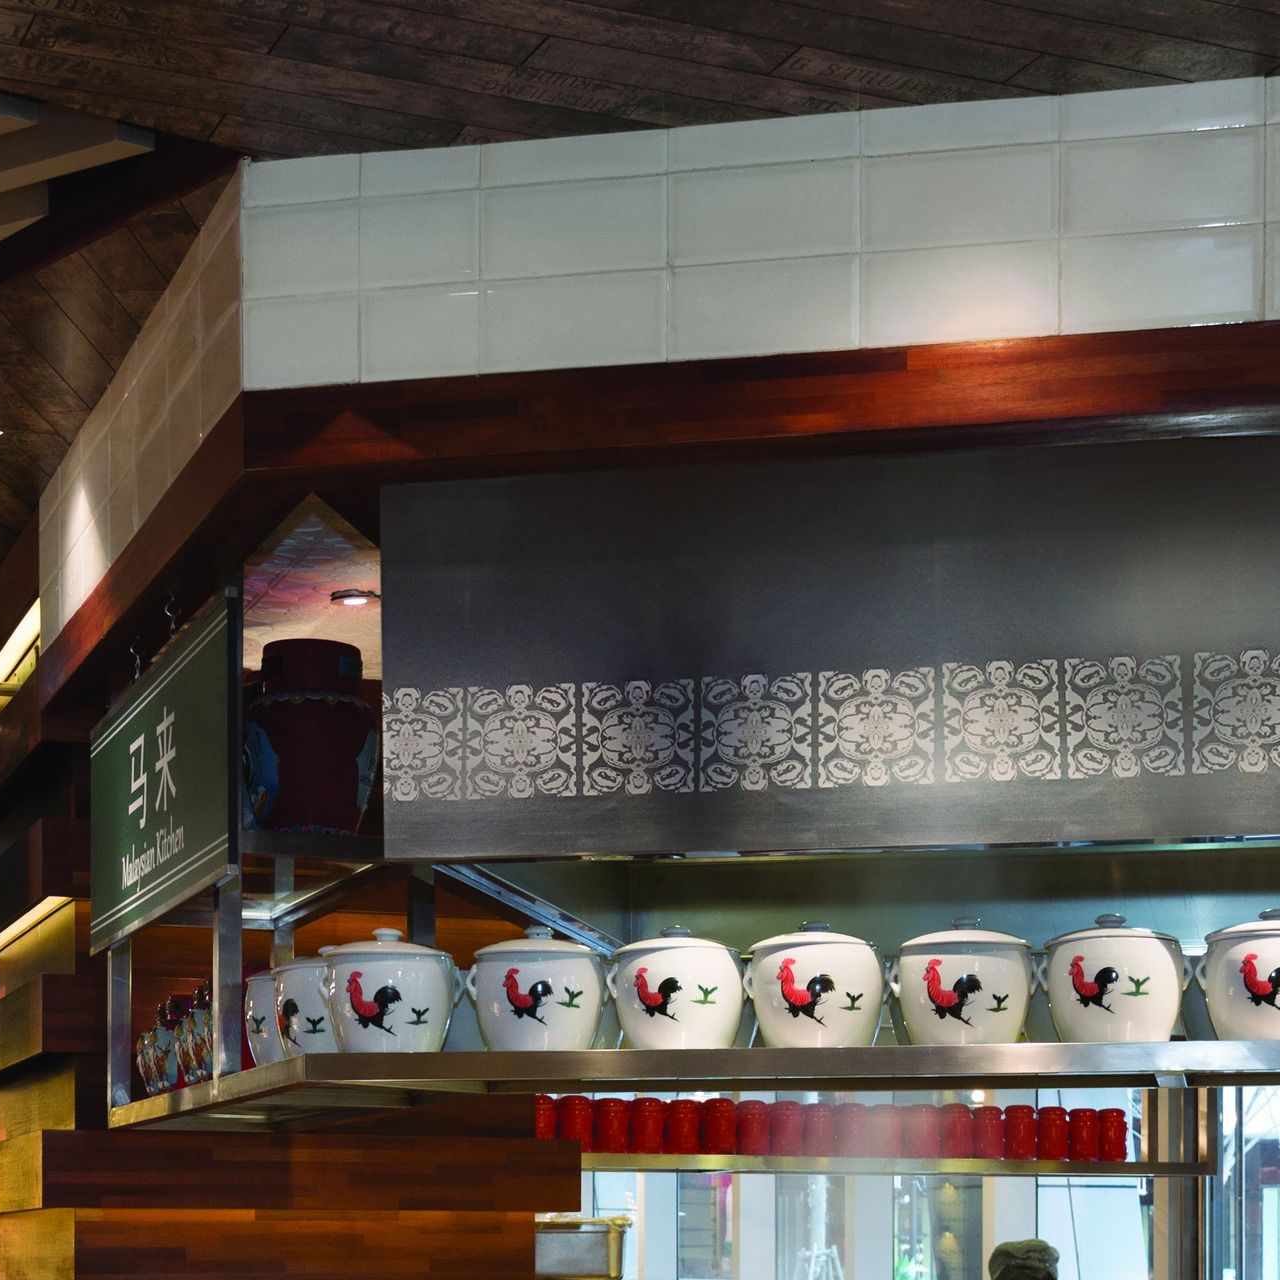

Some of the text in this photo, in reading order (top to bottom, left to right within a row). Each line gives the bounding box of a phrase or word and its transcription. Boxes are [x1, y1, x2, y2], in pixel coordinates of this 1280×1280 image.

[128, 706, 177, 829] 马来
[121, 815, 185, 893] Malaysian Kitchen
